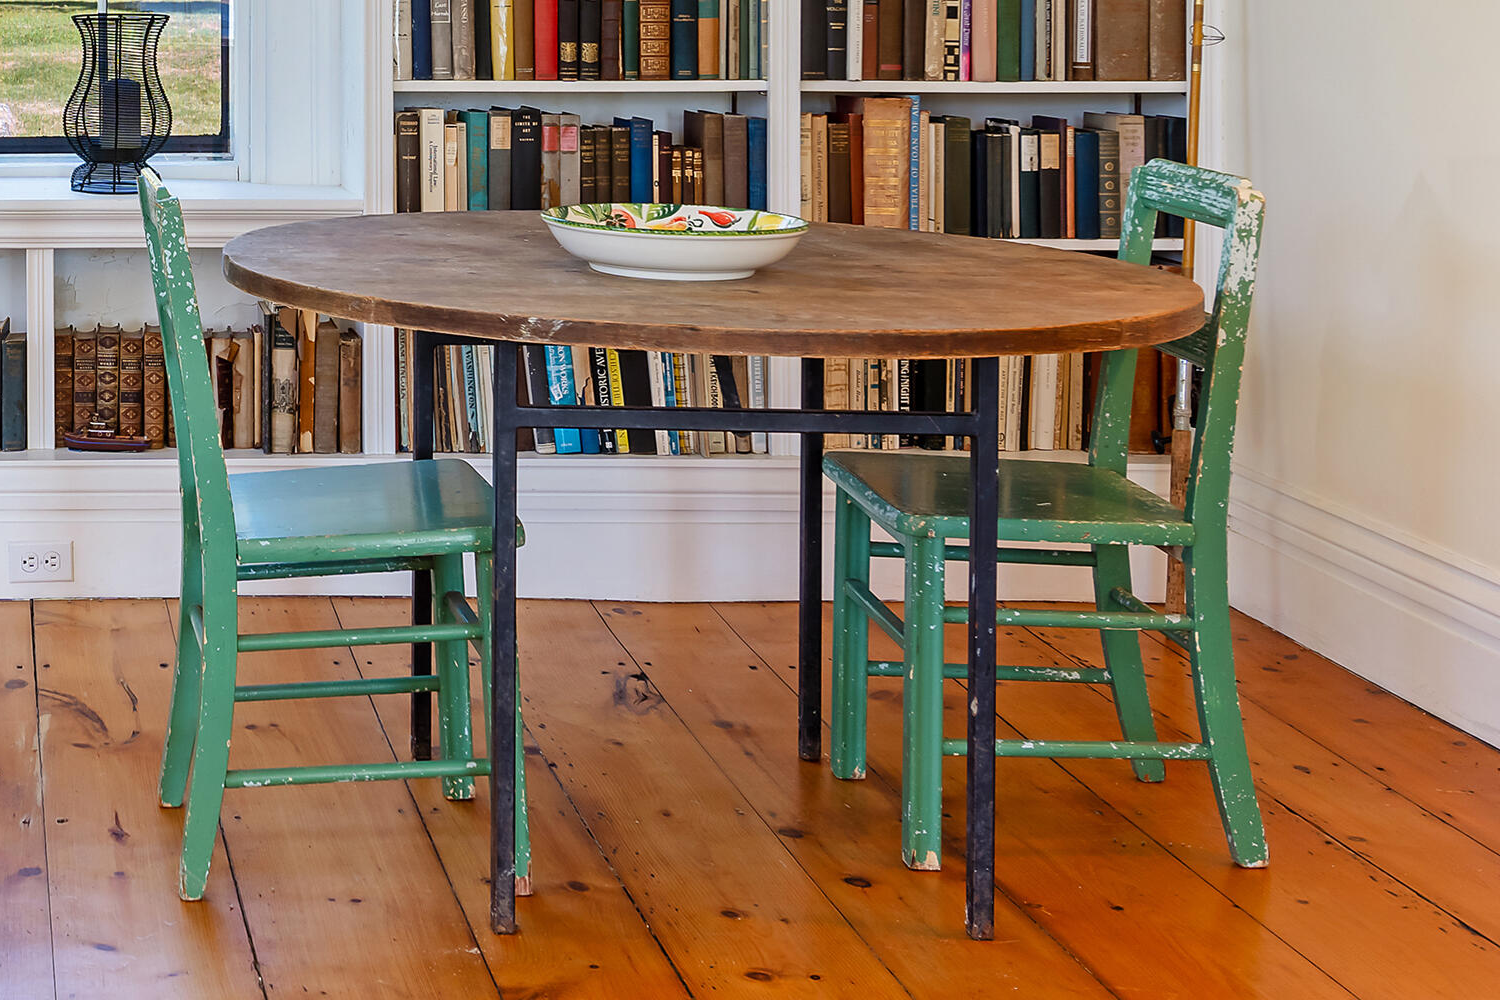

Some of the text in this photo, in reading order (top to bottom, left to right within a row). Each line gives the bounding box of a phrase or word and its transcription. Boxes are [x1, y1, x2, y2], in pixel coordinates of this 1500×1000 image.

[911, 99, 919, 117] ARC
[911, 120, 918, 133] OF
[815, 154, 824, 196] Contemplation
[911, 167, 918, 178] OF
[465, 350, 476, 409] WASHINGTON
[558, 363, 569, 395] WORKS
